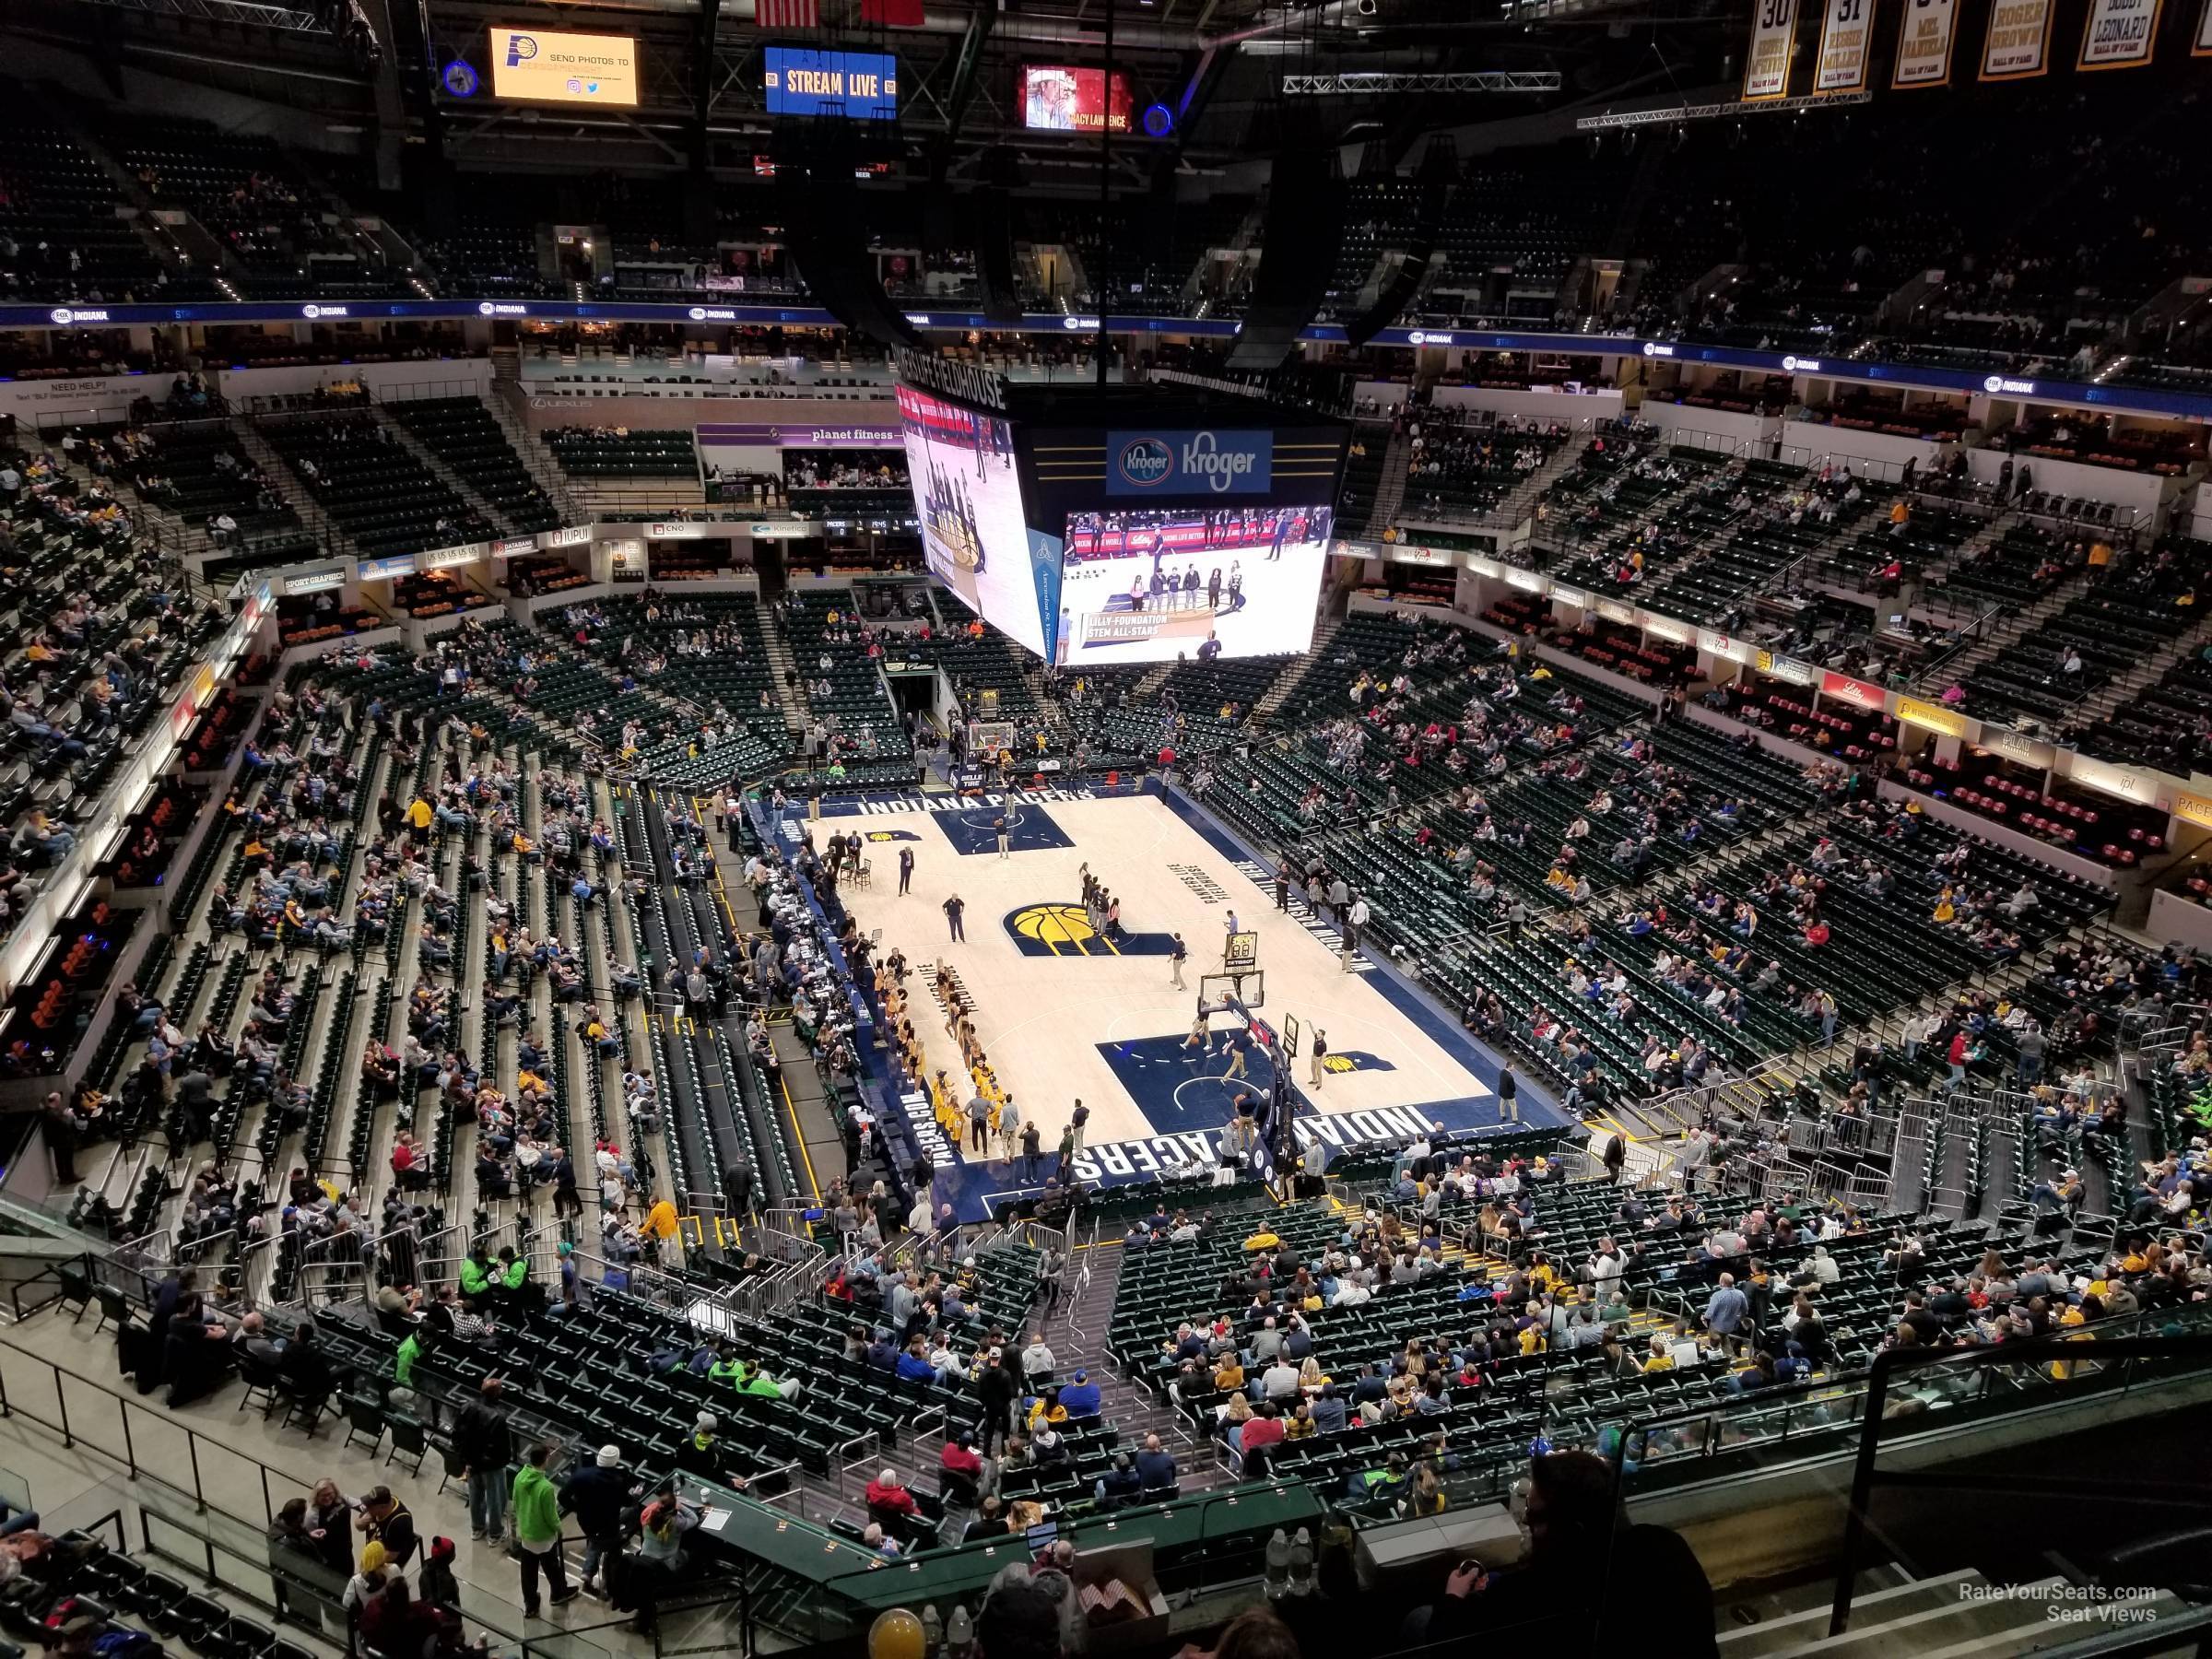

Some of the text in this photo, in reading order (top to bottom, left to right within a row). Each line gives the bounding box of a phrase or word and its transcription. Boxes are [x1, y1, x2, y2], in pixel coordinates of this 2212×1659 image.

[1995, 3, 2043, 28] ROGER
[2093, 16, 2147, 43] LEONARD
[1990, 26, 2041, 50] BROWN
[550, 54, 629, 66] SEND PHOTOS TO
[787, 70, 842, 95] STREAM
[849, 74, 877, 97] LIVE
[1070, 113, 1126, 127] RACY LAWENCE
[74, 311, 109, 321] INDIANA
[321, 306, 347, 315] INDIANA
[495, 304, 526, 314] INDIANA
[707, 310, 735, 319] INDIANA
[1425, 334, 1453, 344] INDIANA
[1796, 359, 1819, 371] INDIANA
[52, 381, 107, 391] NEED HELP?
[932, 356, 1006, 410] FIELDHOUSE
[2003, 380, 2033, 394] INDIANA
[547, 400, 593, 408] LEXUS
[812, 429, 893, 441] planet fitness
[1127, 446, 1167, 477] Kroger
[1182, 431, 1255, 492] Kroger
[564, 528, 589, 543] IUPUI
[666, 524, 684, 533] CNO
[504, 539, 534, 550] DATABANK
[285, 571, 346, 588] SPORT GRAPHICS
[1088, 626, 1159, 639] STEM ALL-STARS
[1843, 680, 1865, 701] Lilly
[2003, 733, 2031, 752] PLAT
[2120, 774, 2136, 791] ipl
[857, 788, 1097, 814] INDIANA PACERS
[1180, 877, 1218, 904] BANKERS
[1184, 865, 1231, 900] FIELDHOUSE
[900, 1090, 956, 1169] PACERS.COM
[1294, 1105, 1436, 1147] INDIAN
